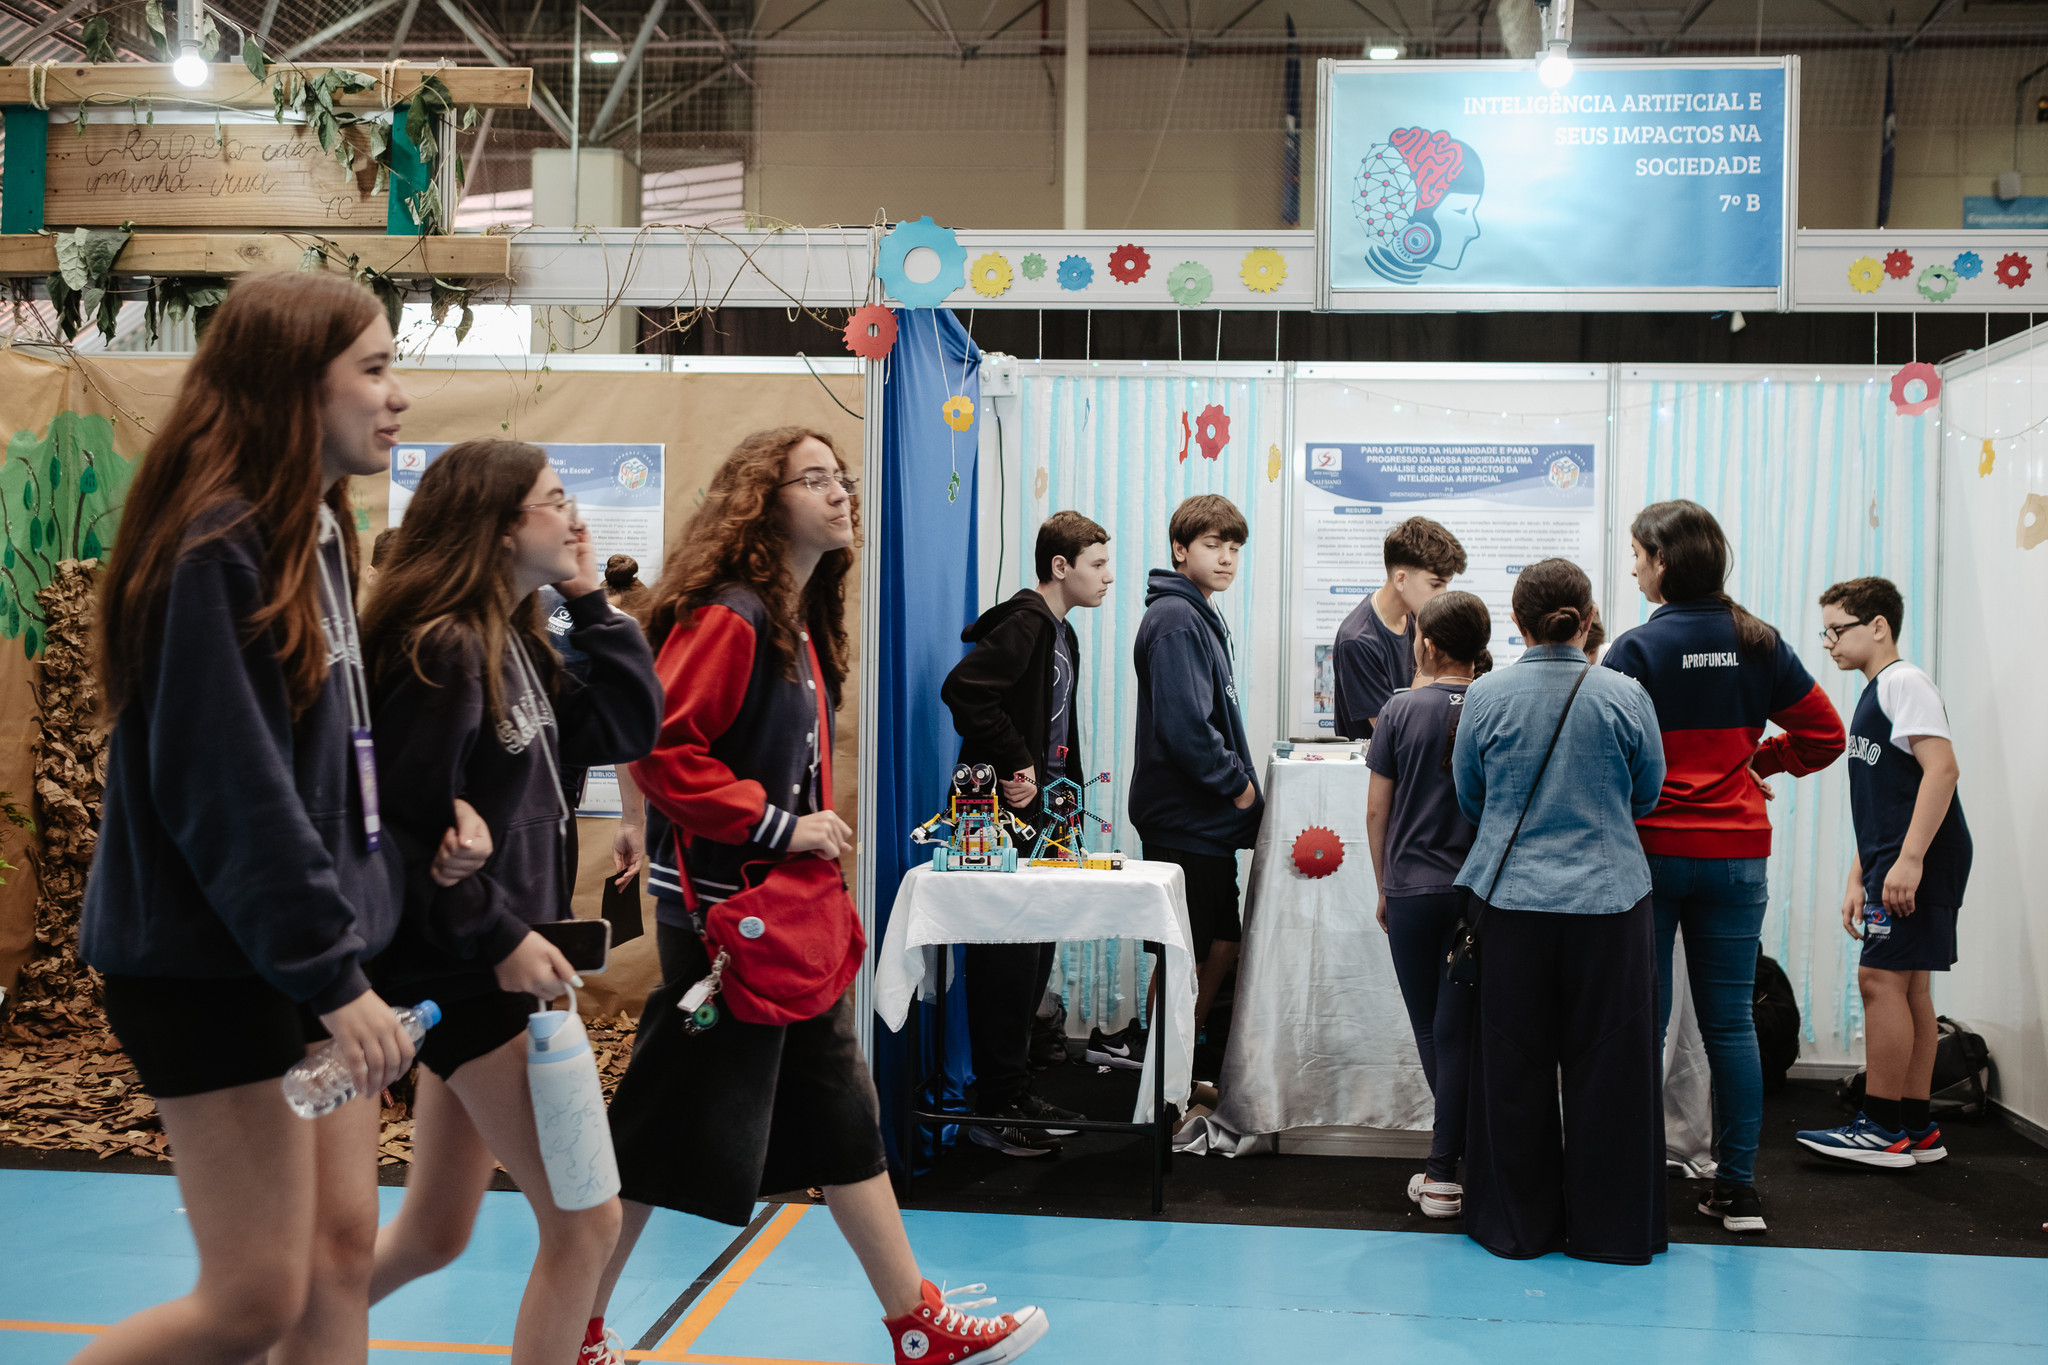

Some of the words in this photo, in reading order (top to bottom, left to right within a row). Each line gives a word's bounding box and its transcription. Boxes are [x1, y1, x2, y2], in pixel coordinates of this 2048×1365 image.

[1464, 90, 1617, 115] INTELIGÊNCIA
[1621, 92, 1744, 112] ARTIFICIAL
[1749, 92, 1762, 111] E
[1554, 126, 1609, 146] SEUS
[1613, 125, 1724, 144] IMPACTOS
[1729, 124, 1762, 143] NA
[1635, 156, 1761, 176] SOCIEDADE
[1746, 193, 1761, 212] B
[1361, 446, 1384, 455] PARA
[1386, 446, 1393, 455] O
[1394, 447, 1427, 455] FUTURO
[1429, 447, 1441, 455] DA
[1443, 447, 1498, 455] HUMANIDADE
[1500, 447, 1505, 455] E
[1507, 447, 1530, 456] PARA
[1532, 447, 1539, 456] O
[1366, 455, 1418, 464] PROGRESSO
[1420, 456, 1432, 464] DA
[1434, 456, 1462, 464] NOSSA
[1380, 464, 1416, 473] ANÁLISE
[1417, 465, 1446, 473] SOBRE
[1448, 465, 1460, 473] OS
[1462, 465, 1504, 474] IMPACTOS
[1506, 465, 1519, 474] DA
[1398, 473, 1454, 483] INTELIGÊNCIA
[1456, 474, 1502, 483] ARTIFICIAL
[1345, 507, 1372, 515] RESUMO
[1682, 652, 1740, 669] APROFUNSAL
